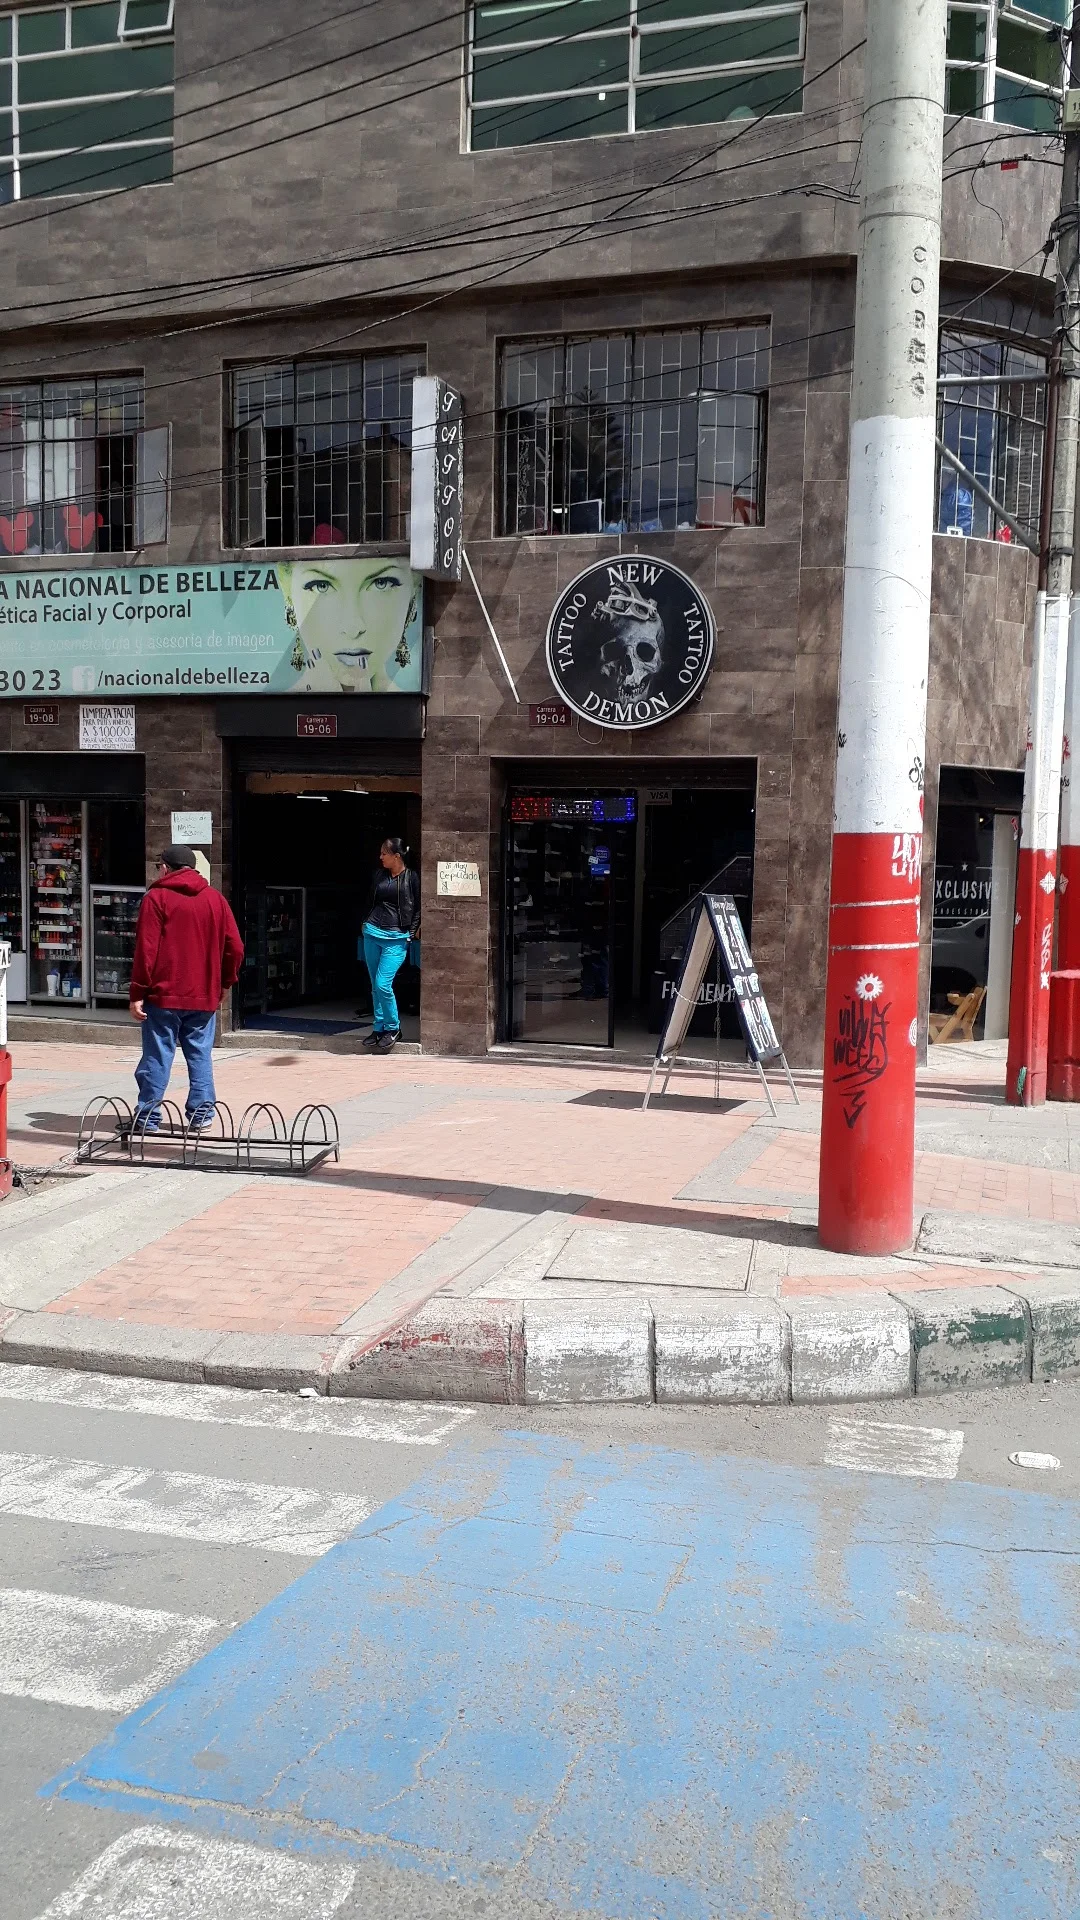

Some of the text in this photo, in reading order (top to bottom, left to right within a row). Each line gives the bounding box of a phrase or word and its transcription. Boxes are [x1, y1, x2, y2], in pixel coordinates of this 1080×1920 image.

[441, 391, 457, 568] TATTOO
[16, 575, 132, 600] NACIONAL
[140, 573, 169, 595] DE
[176, 569, 279, 593] BELLEZA
[607, 563, 664, 586] NEW
[43, 602, 92, 622] Facial
[97, 607, 108, 625] y
[112, 598, 191, 624] Corporal
[207, 629, 223, 647] de
[227, 631, 275, 652] imagen
[557, 593, 587, 672] TATTOO
[678, 603, 704, 684] TATTOO
[30, 713, 54, 723] 19-08
[535, 714, 566, 724] 19-04
[582, 691, 670, 722] DEMON
[304, 724, 331, 734] 19-06
[650, 791, 669, 800] VISA
